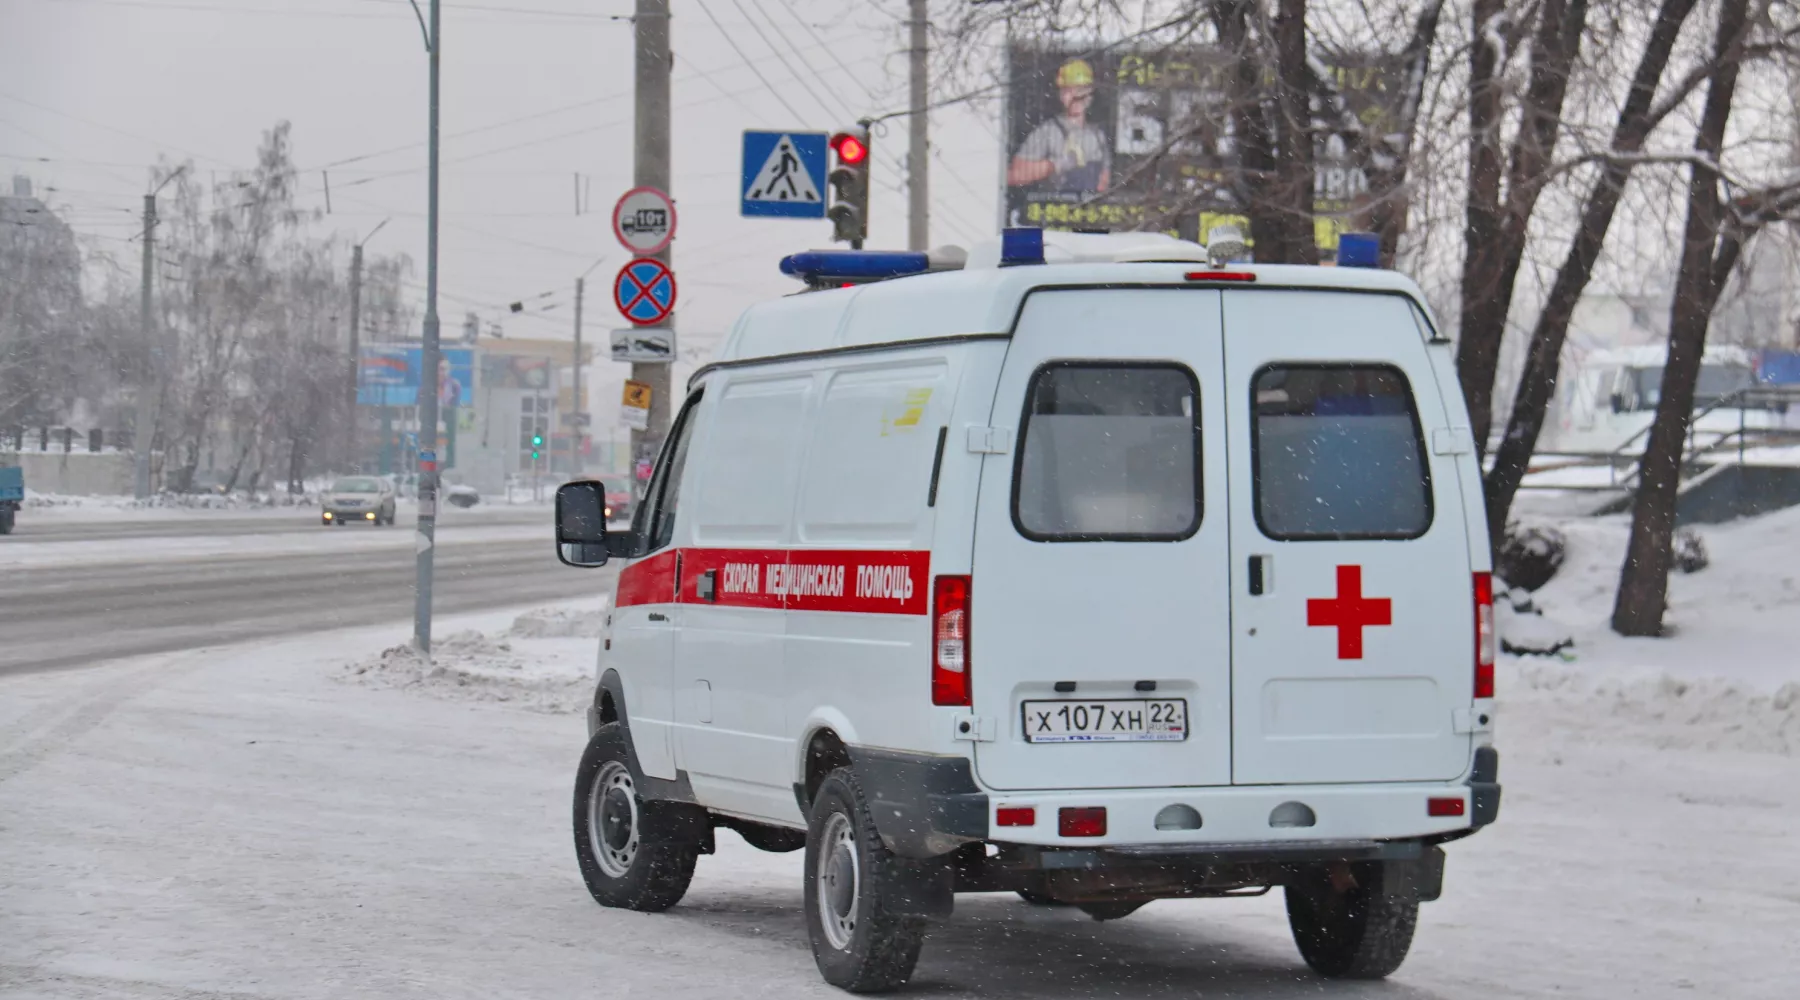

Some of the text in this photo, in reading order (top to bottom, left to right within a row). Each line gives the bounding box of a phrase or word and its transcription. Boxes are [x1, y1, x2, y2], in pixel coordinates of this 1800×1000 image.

[723, 562, 913, 605] СКОРАЯ МЕДИЦИНСКАЯ ПОМОЩЬ
[1150, 703, 1176, 723] 22
[1148, 723, 1168, 731] RUS
